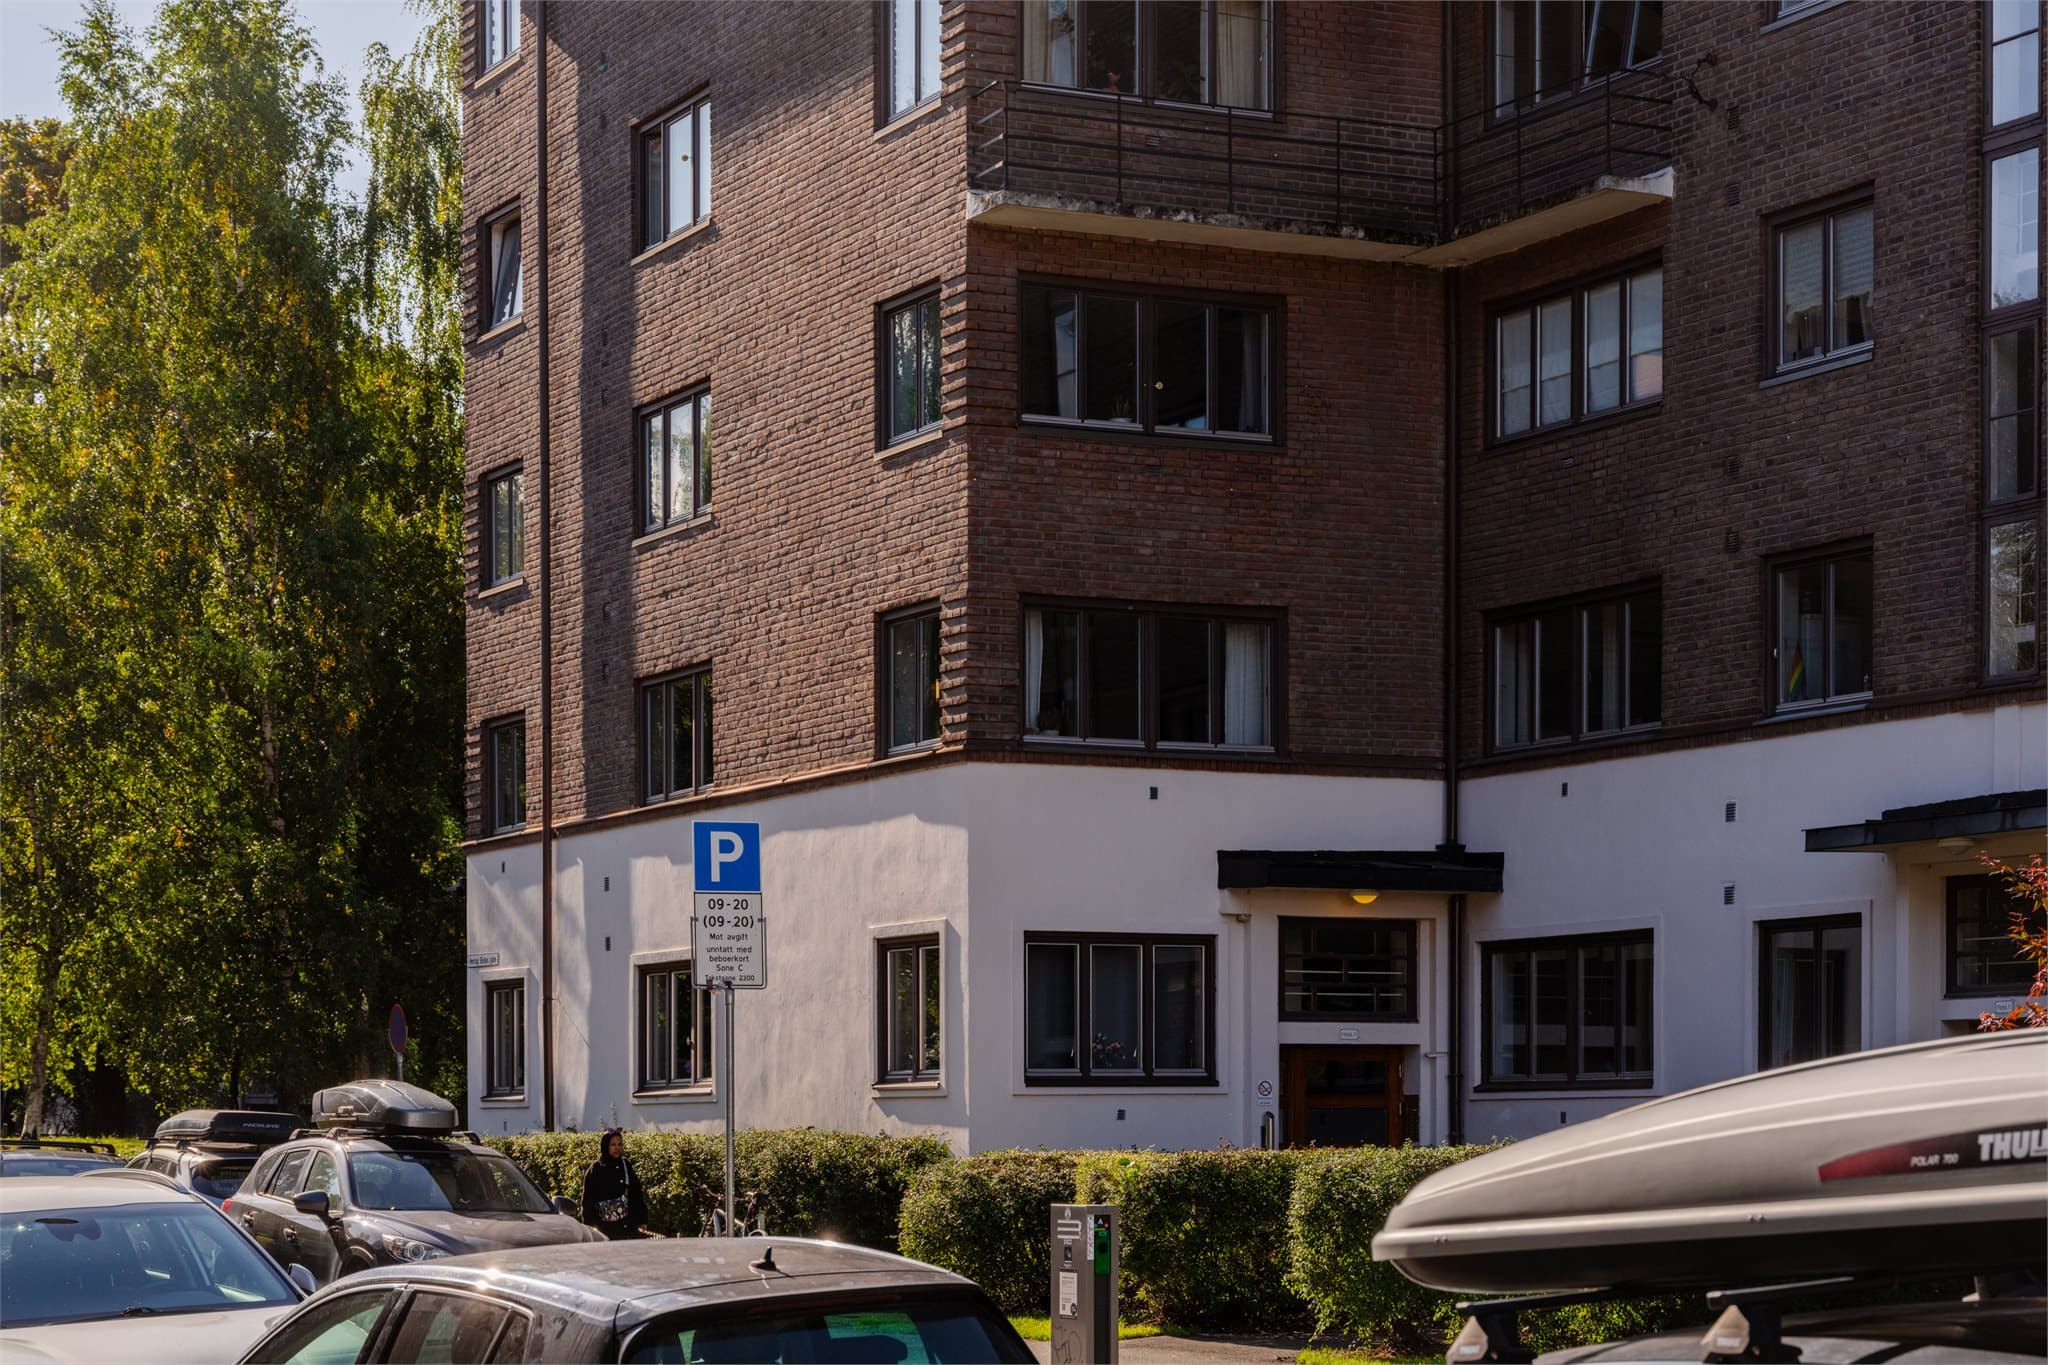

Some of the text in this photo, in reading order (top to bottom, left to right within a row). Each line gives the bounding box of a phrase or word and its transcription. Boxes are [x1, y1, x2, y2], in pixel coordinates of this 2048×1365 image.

[710, 831, 744, 882] P
[727, 933, 748, 942] avgift
[1910, 1154, 1940, 1167] POLAR
